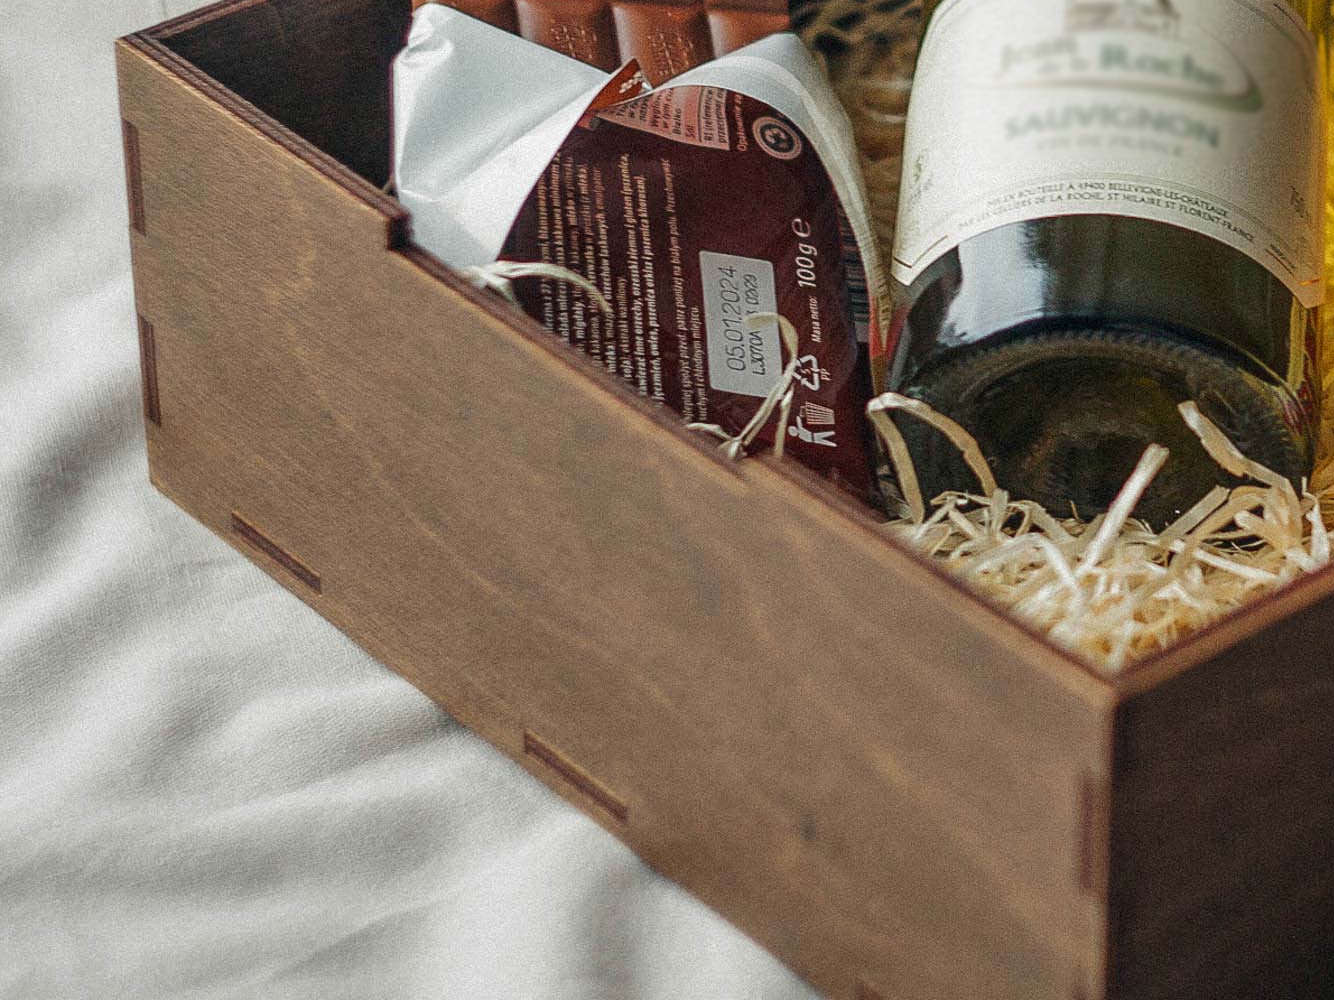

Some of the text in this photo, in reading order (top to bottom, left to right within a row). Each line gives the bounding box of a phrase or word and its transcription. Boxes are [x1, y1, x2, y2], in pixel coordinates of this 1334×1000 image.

[670, 234, 680, 264] białym
[799, 243, 818, 256] g
[671, 264, 682, 276] na
[794, 255, 817, 288] 100
[717, 264, 746, 372] 05.01.2024
[809, 320, 823, 343] Masa
